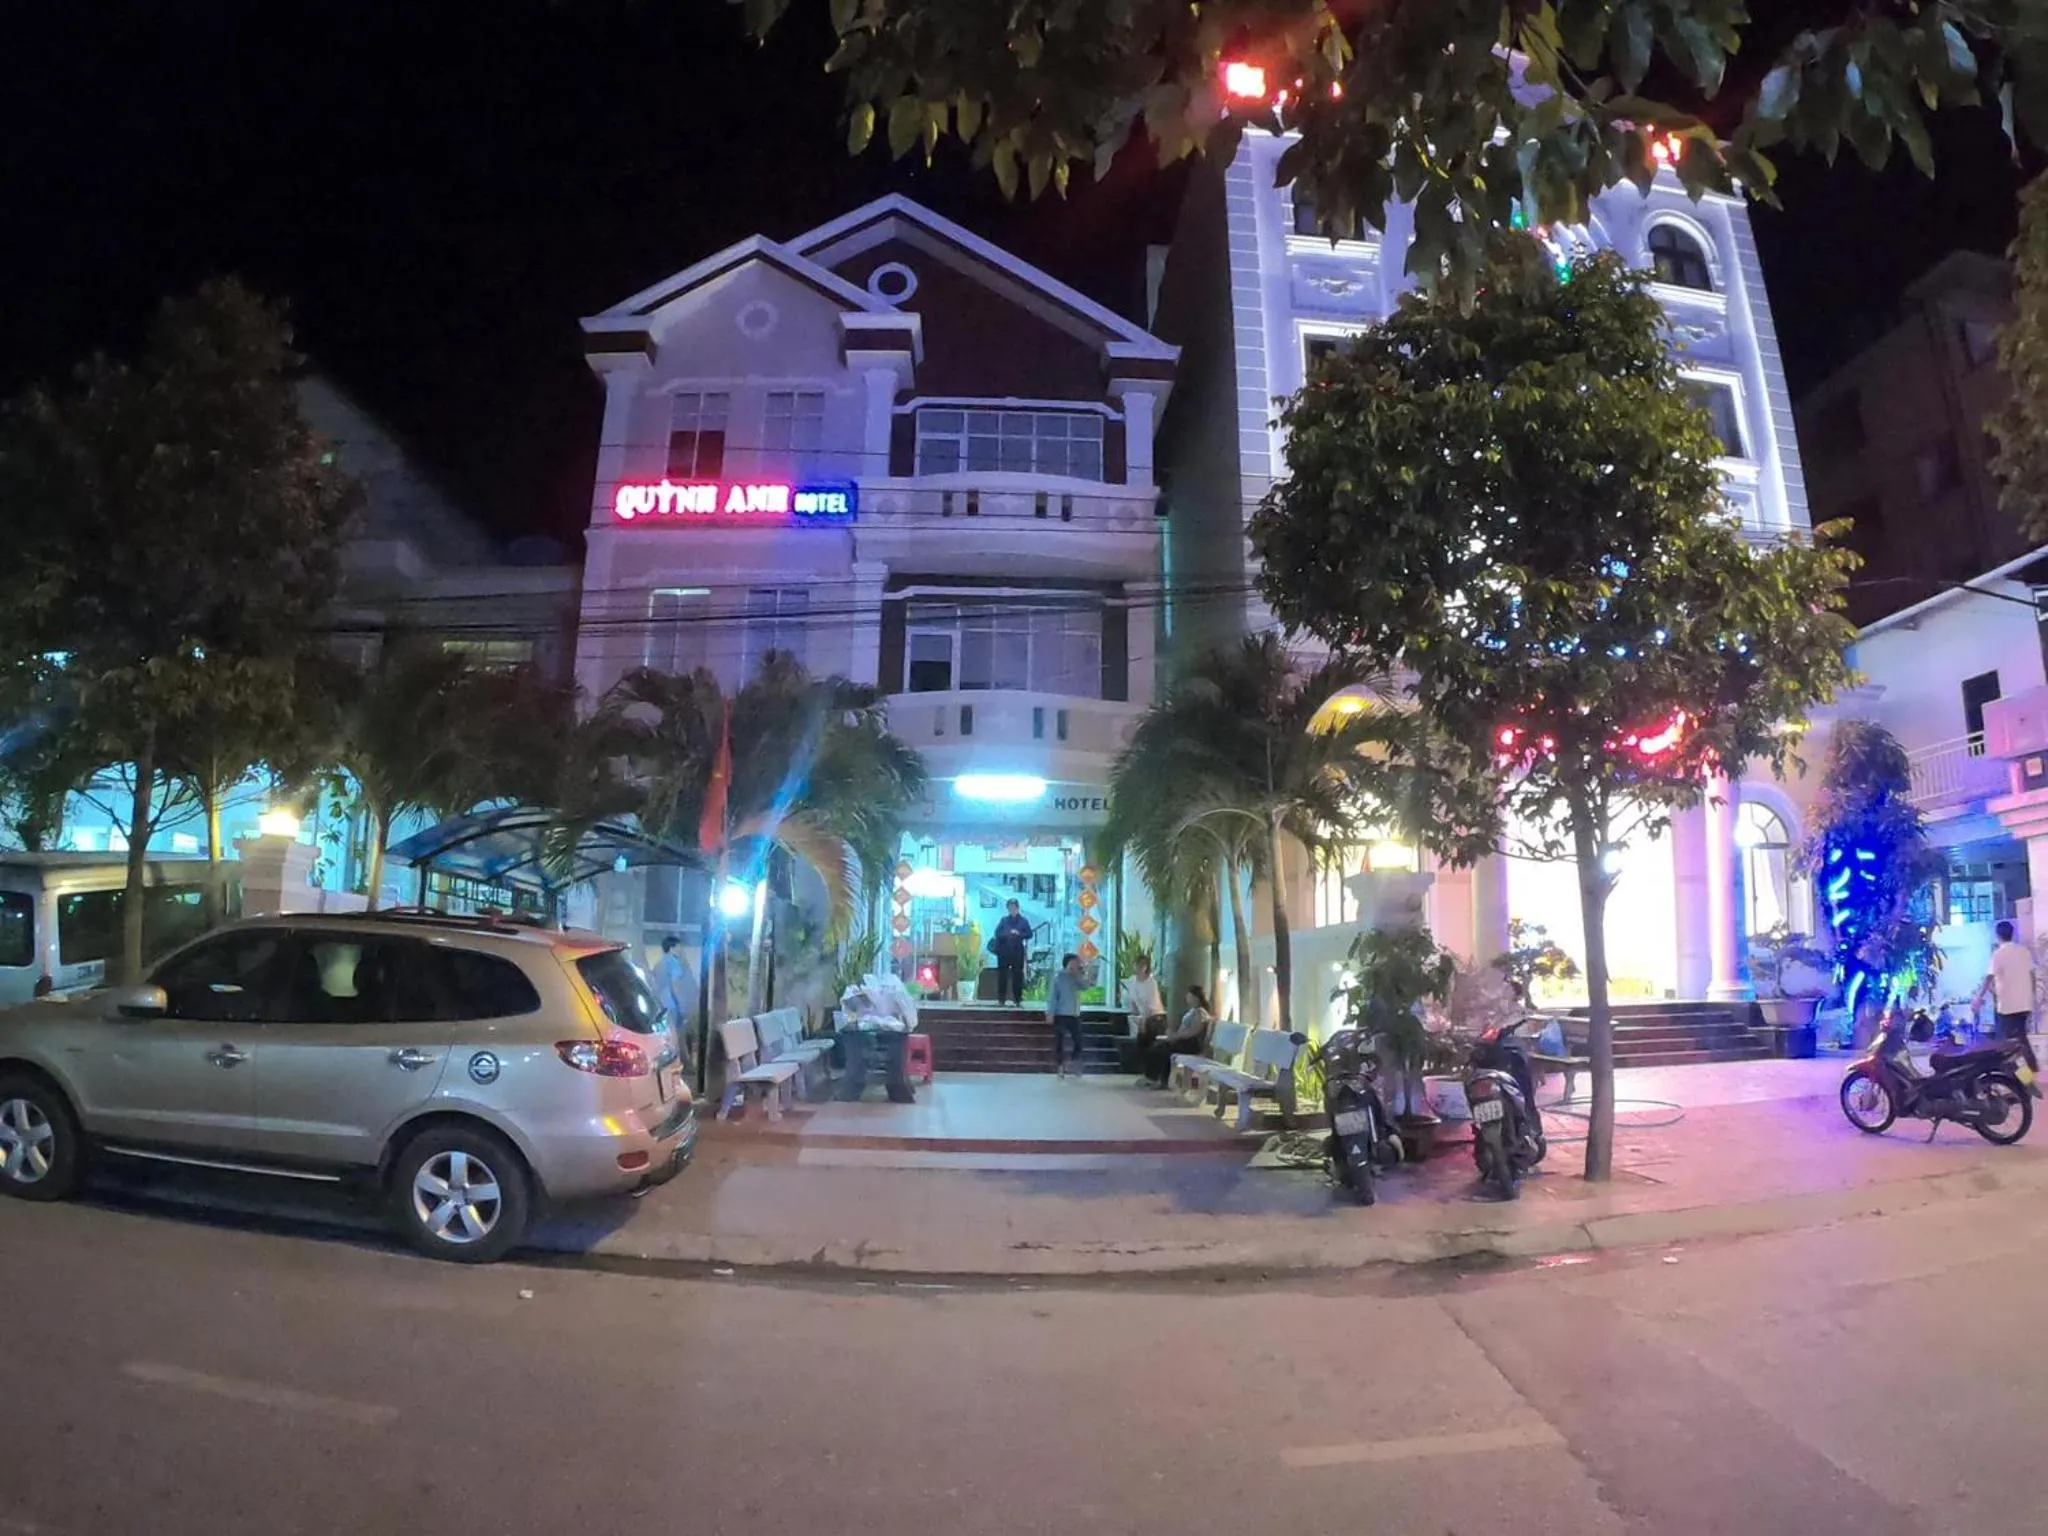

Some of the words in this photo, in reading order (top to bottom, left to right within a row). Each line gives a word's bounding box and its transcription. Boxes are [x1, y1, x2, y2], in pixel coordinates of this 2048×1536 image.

[725, 485, 789, 512] ANH
[795, 493, 848, 514] HOTEL
[1055, 798, 1111, 811] HOTEL
